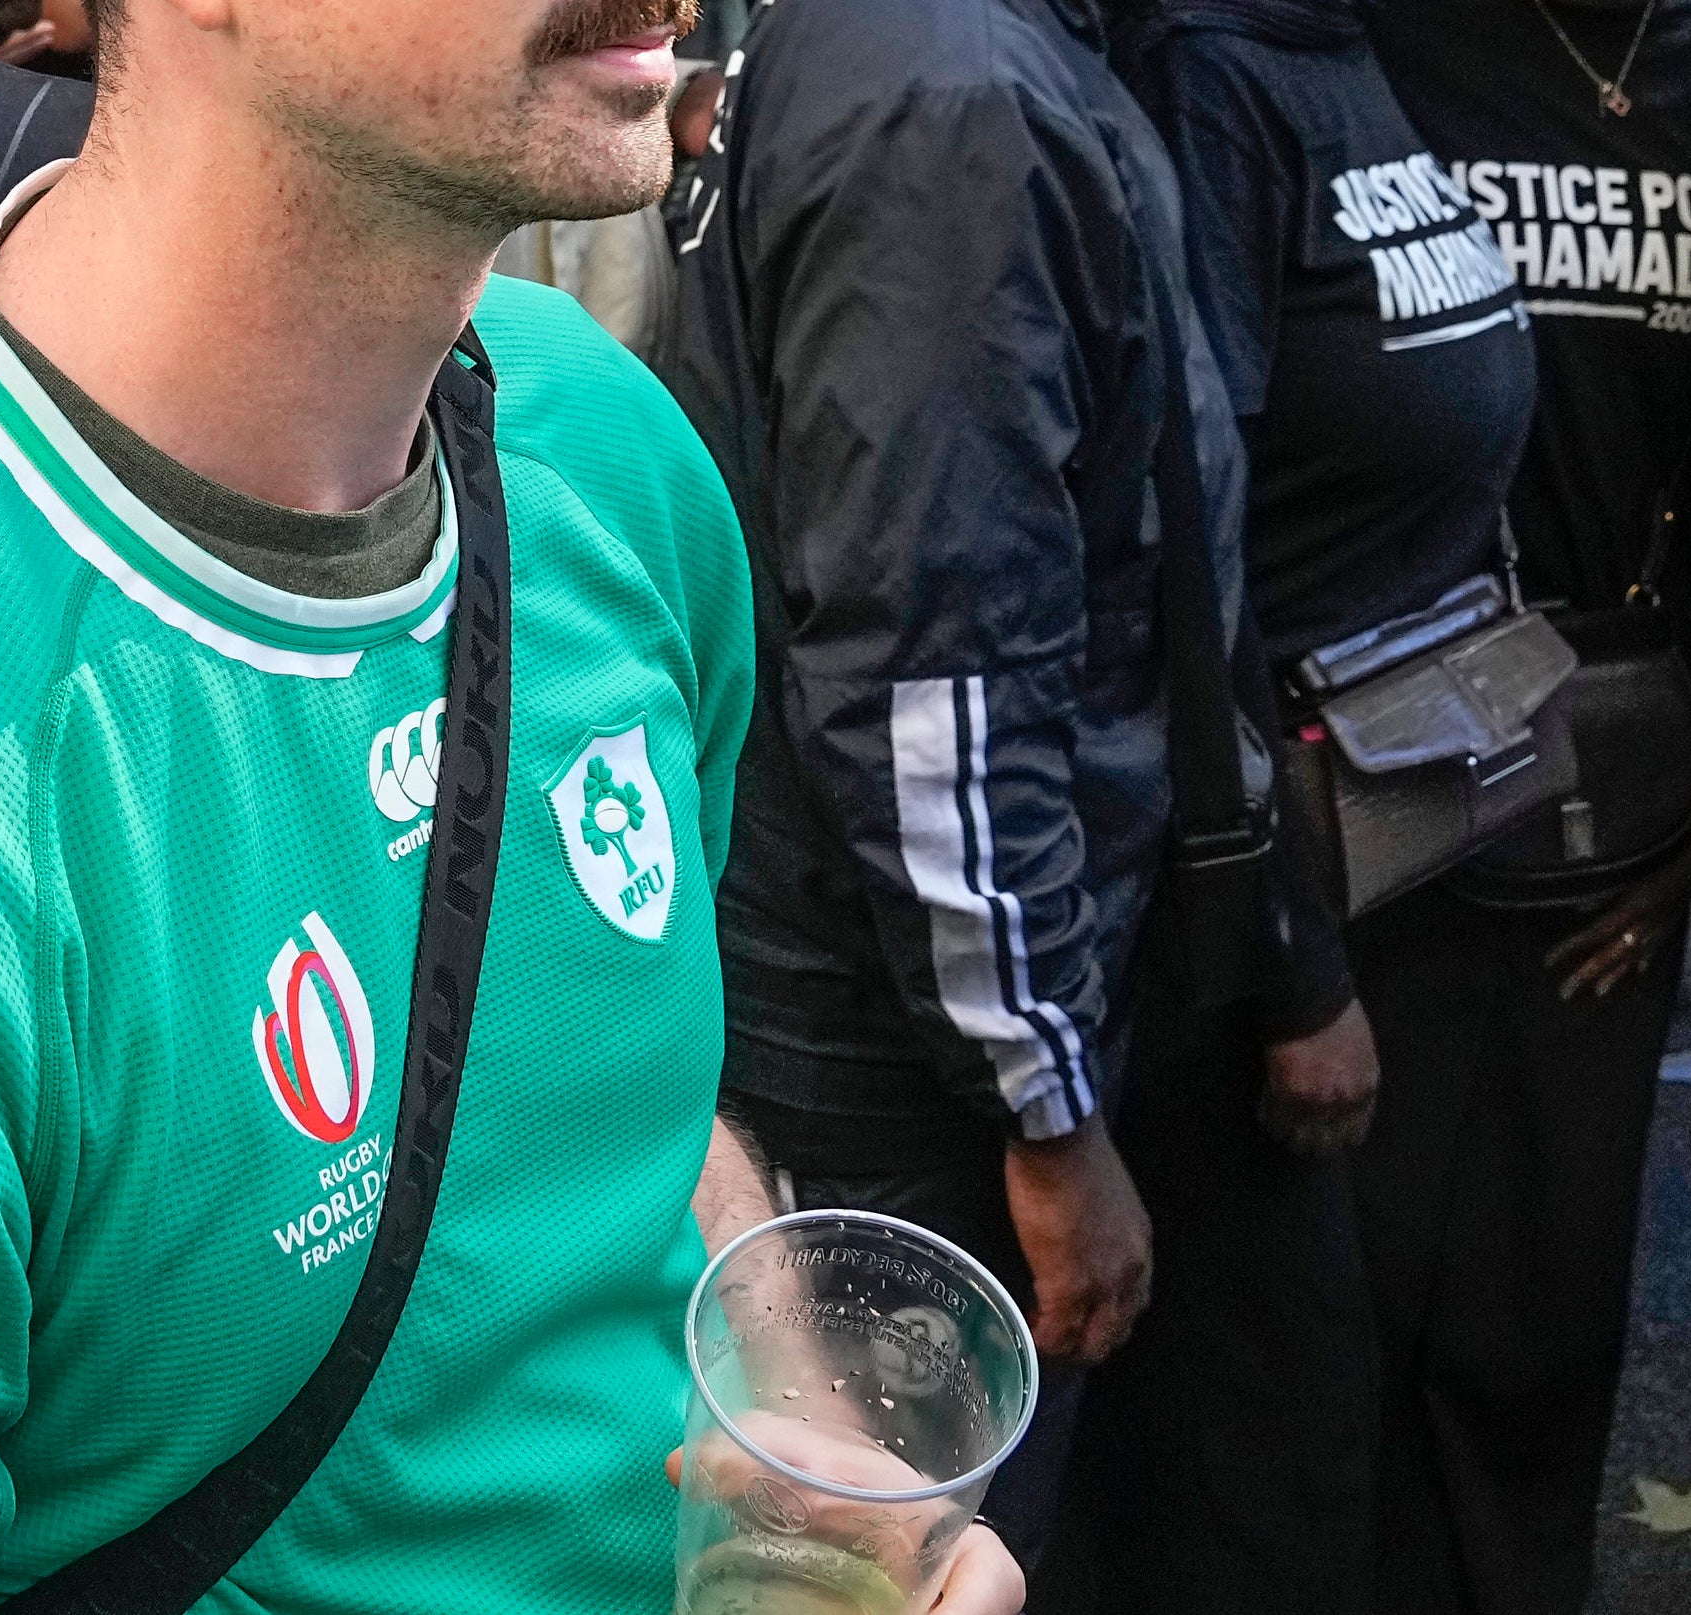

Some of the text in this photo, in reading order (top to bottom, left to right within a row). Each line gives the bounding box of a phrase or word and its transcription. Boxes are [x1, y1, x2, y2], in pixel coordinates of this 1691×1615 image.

[319, 1133, 381, 1191] RUGBY
[273, 1170, 381, 1254] WORLD
[301, 1210, 374, 1274] FRANCE
